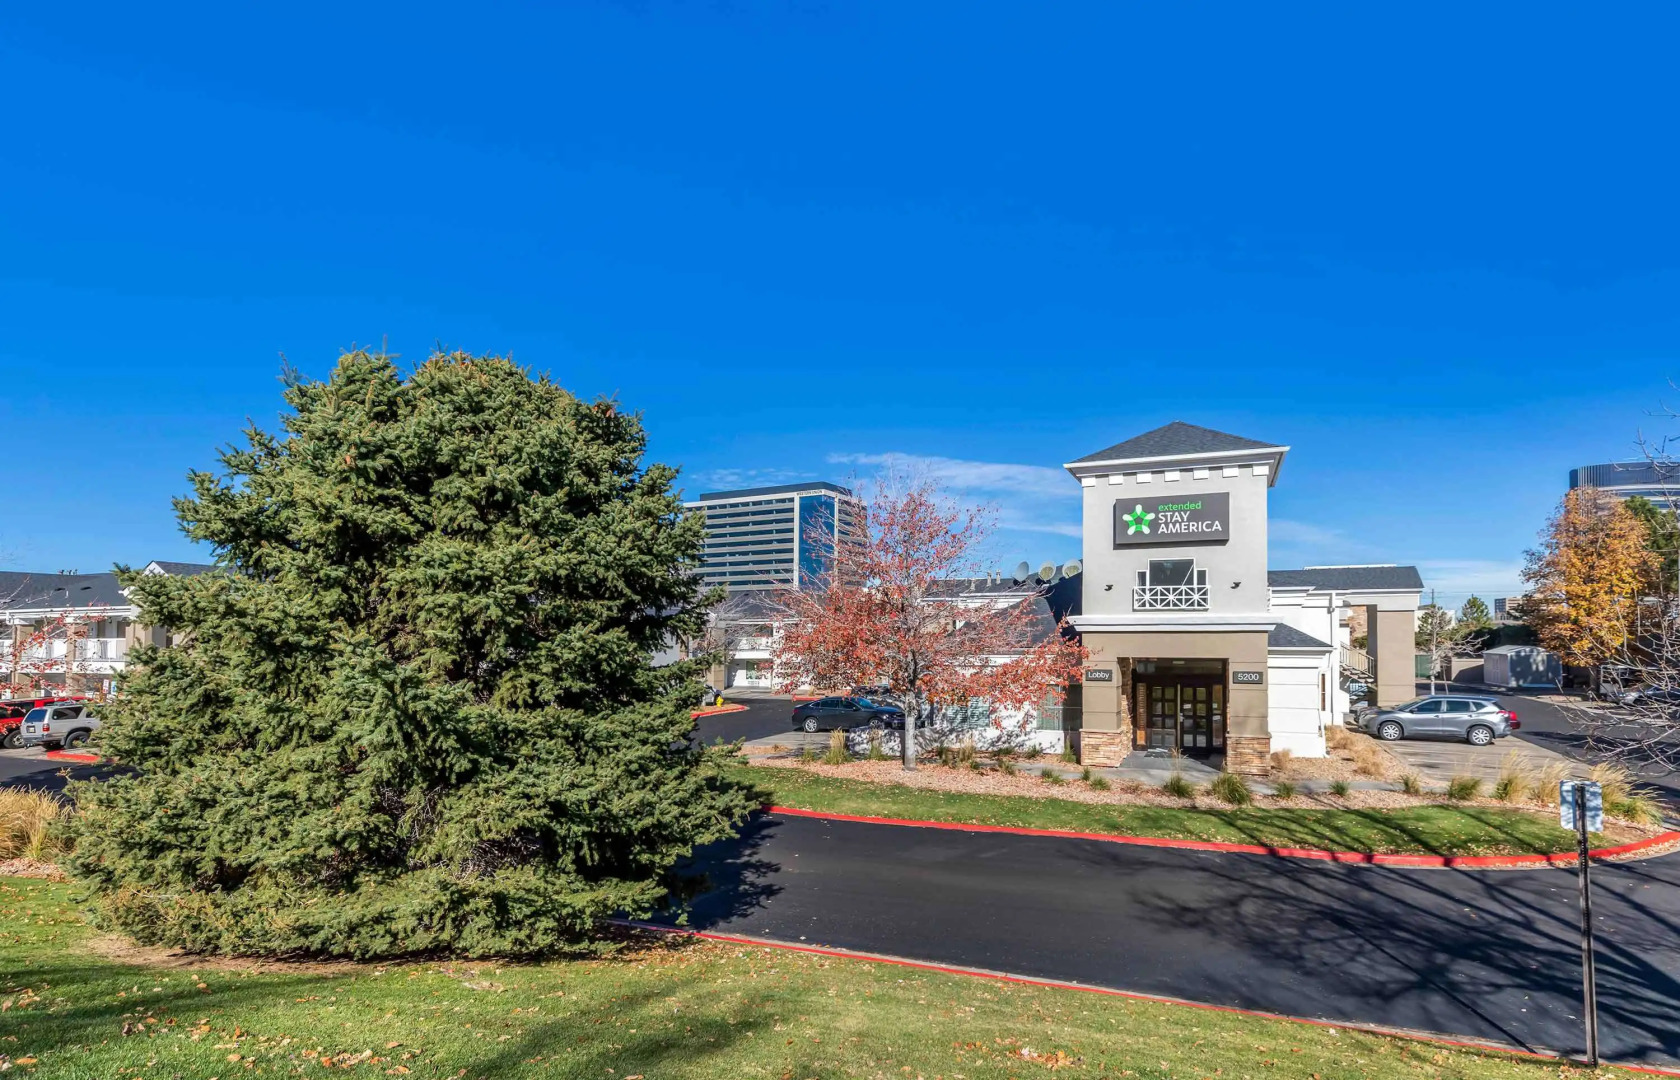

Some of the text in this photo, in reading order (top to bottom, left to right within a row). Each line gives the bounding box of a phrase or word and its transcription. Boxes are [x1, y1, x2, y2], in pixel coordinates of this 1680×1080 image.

[1158, 500, 1202, 511] extended
[1158, 510, 1190, 523] STAY
[1157, 520, 1222, 534] AMERICA
[1088, 671, 1110, 680] Lobby
[1237, 672, 1260, 681] 5200
